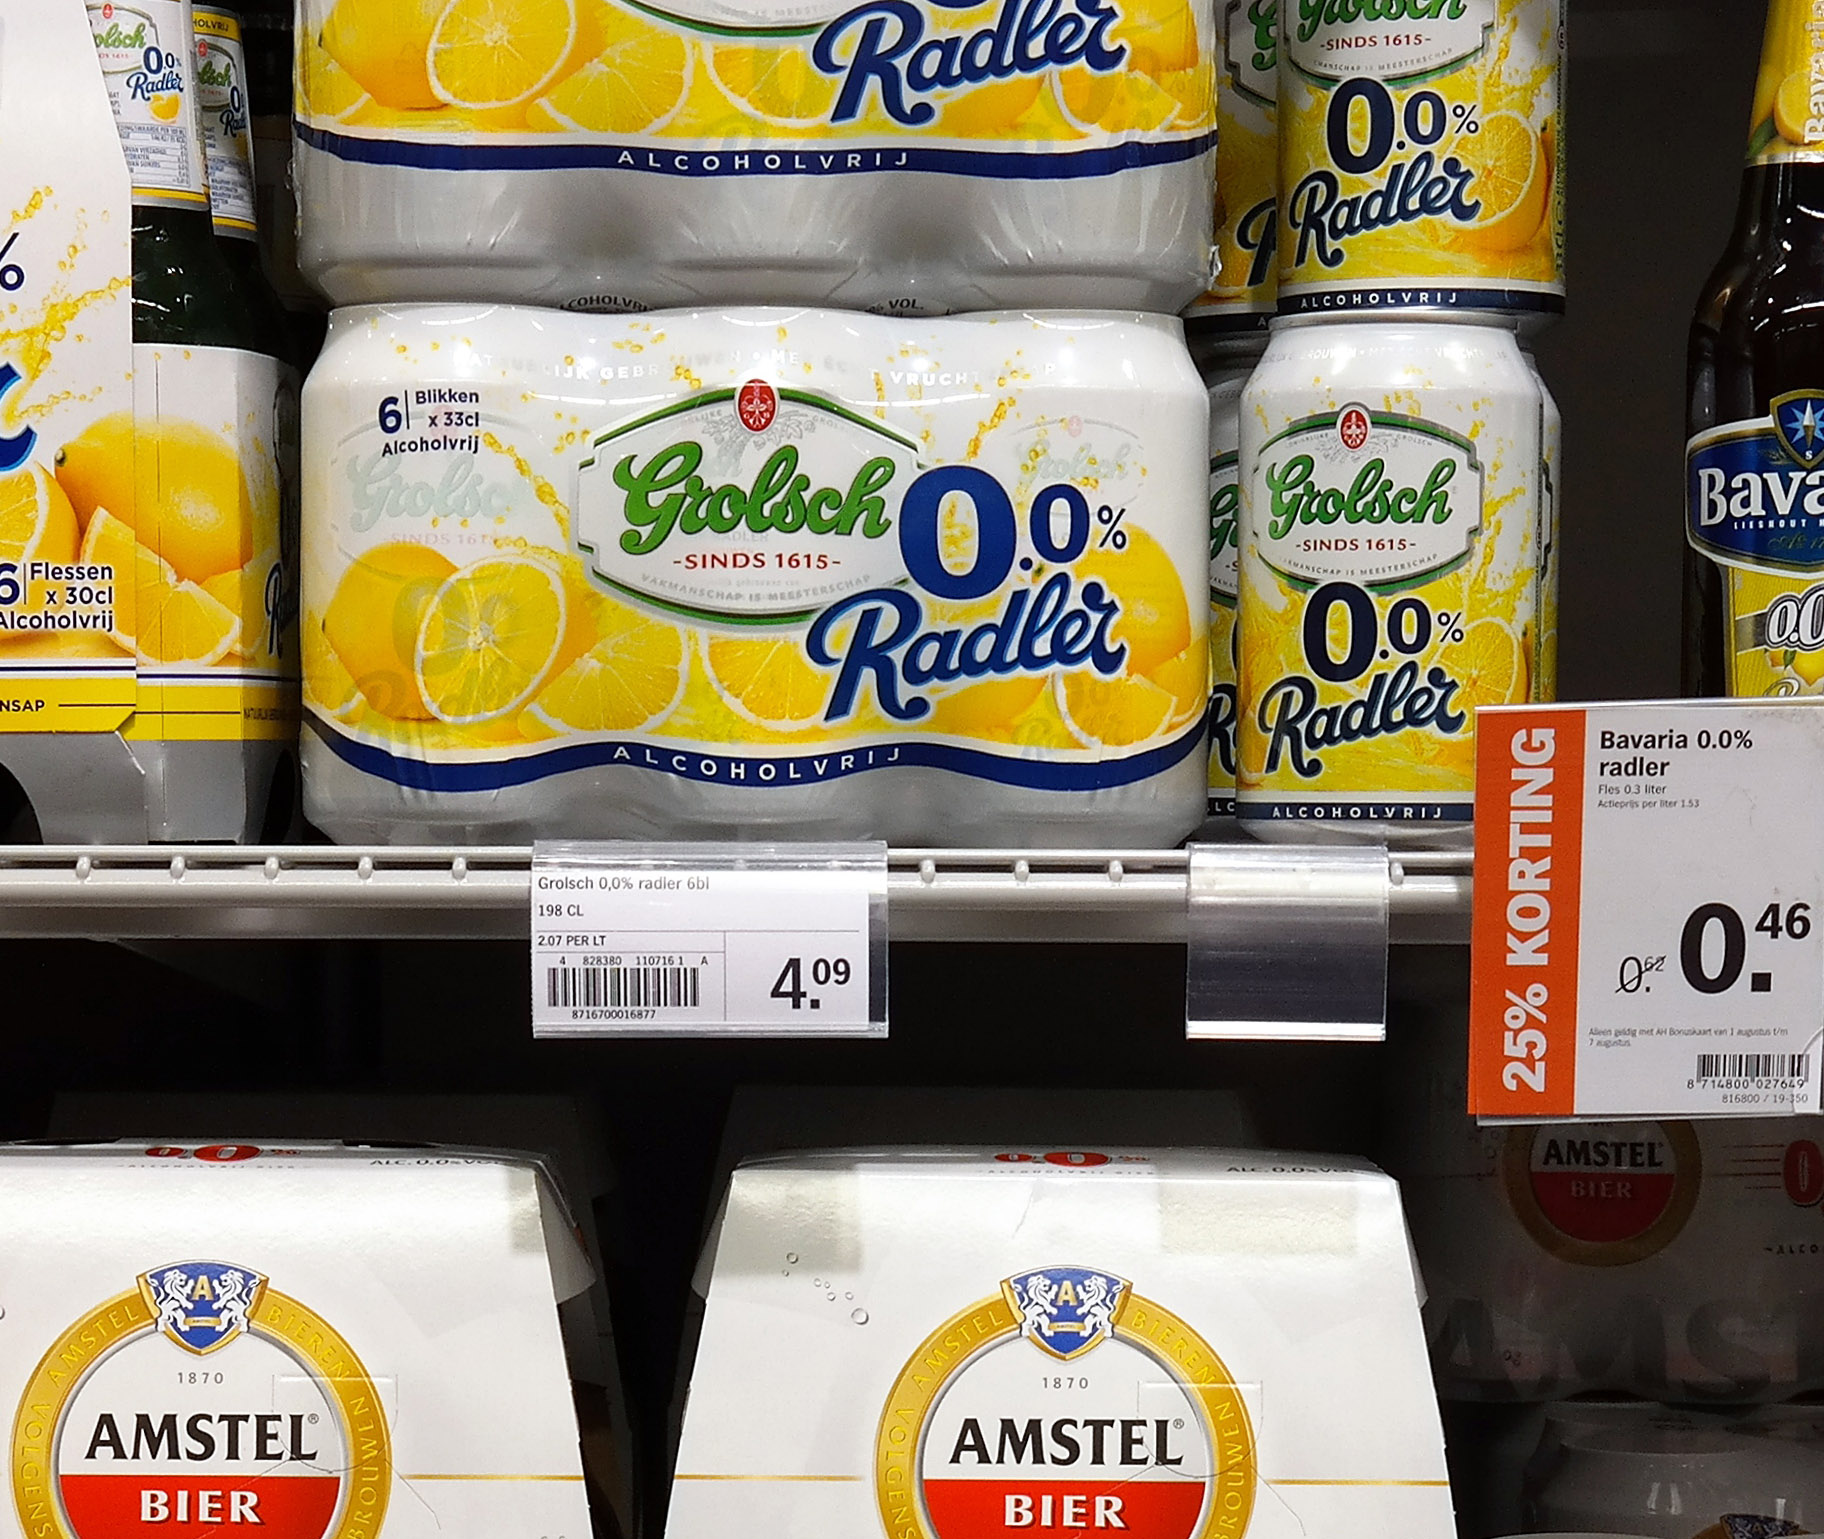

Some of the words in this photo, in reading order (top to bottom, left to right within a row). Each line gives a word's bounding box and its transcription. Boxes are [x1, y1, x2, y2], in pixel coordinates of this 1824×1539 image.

[611, 440, 896, 558] Grolsch
[1267, 454, 1457, 540] Grolsch
[898, 464, 1128, 600] 0.0%
[30, 562, 113, 581] Flessen
[45, 591, 58, 605] x
[65, 586, 113, 605] 30cl
[805, 572, 1128, 723] Radler
[1259, 661, 1466, 777] Radler
[1599, 729, 1689, 750] Bavaria
[1696, 729, 1753, 750] 0.0%
[613, 744, 902, 782] ALCOHOLVRIJ
[1598, 756, 1670, 777] radler
[1598, 783, 1621, 795] Fles
[1623, 783, 1641, 795] 0.3
[1644, 783, 1667, 795] liter
[1273, 805, 1442, 820] ALCOHOLVRIJ
[1506, 727, 1556, 966] KORTING
[538, 876, 594, 890] Grolsch
[598, 876, 634, 892] 0,0%
[638, 876, 682, 890] radler
[686, 876, 710, 890] 6bl
[538, 904, 563, 917] 198
[567, 904, 584, 917] CL
[538, 935, 563, 946] 2.07
[566, 935, 589, 946] PER
[592, 935, 606, 946] LT
[1680, 902, 1811, 995] 0.46
[770, 957, 851, 1010] 4.09
[572, 1009, 656, 1020] 8716700016877
[1502, 982, 1549, 1093] 25%
[948, 1416, 1185, 1468] AMSTEL
[1003, 1493, 1127, 1530] BIER
